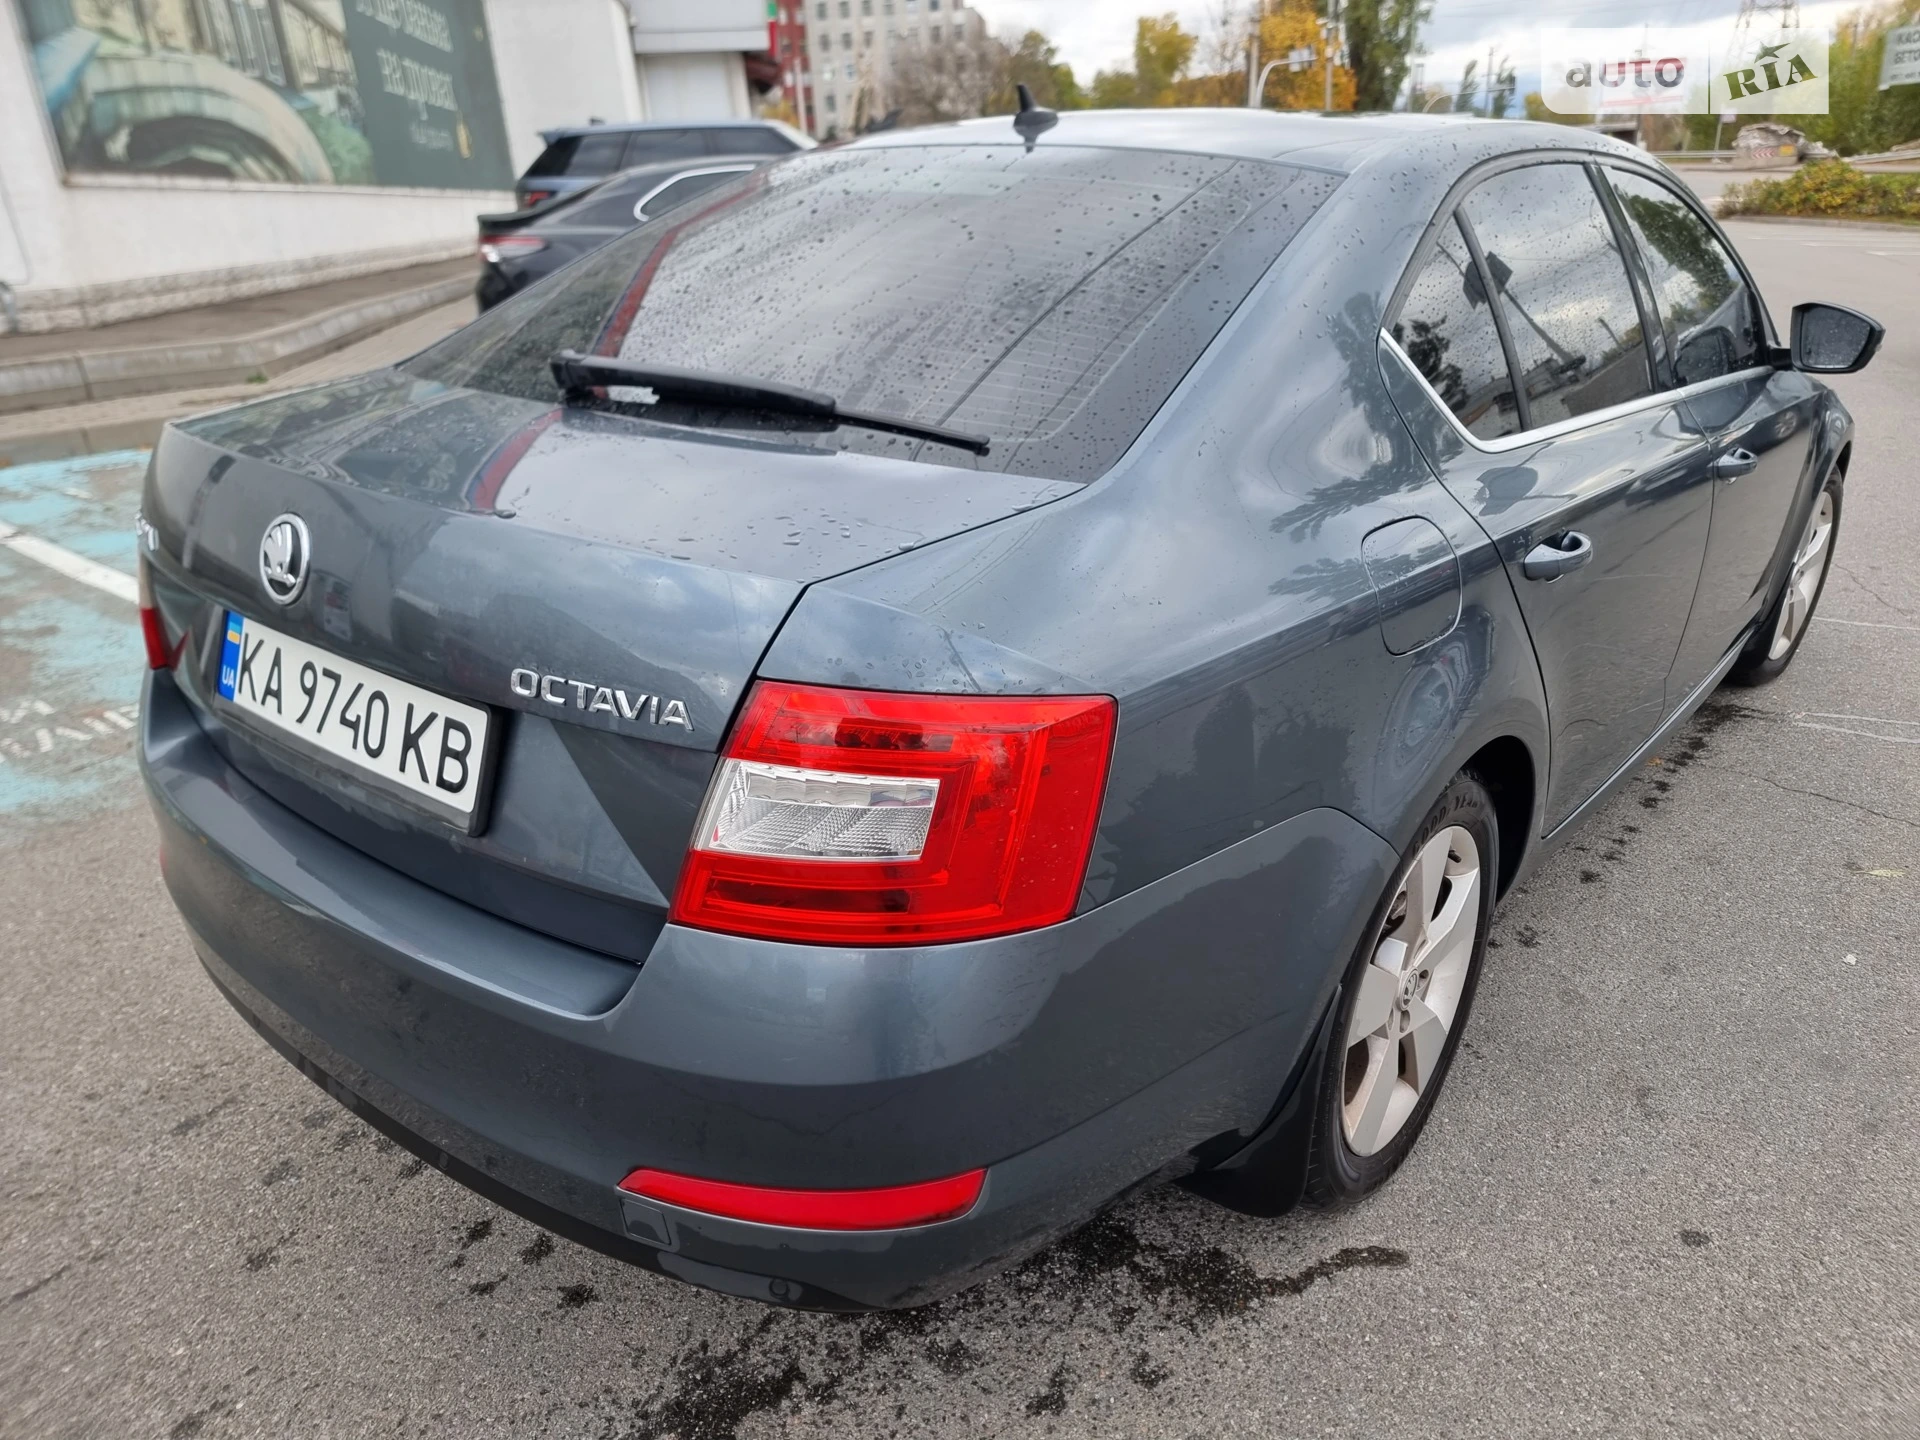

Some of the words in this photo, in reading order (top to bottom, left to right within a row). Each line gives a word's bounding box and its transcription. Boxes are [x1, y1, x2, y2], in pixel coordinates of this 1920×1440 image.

[221, 664, 235, 689] UA
[510, 667, 695, 732] OCTAVIA
[238, 632, 283, 716] KA
[295, 660, 390, 760] 9740
[399, 702, 473, 794] KB
